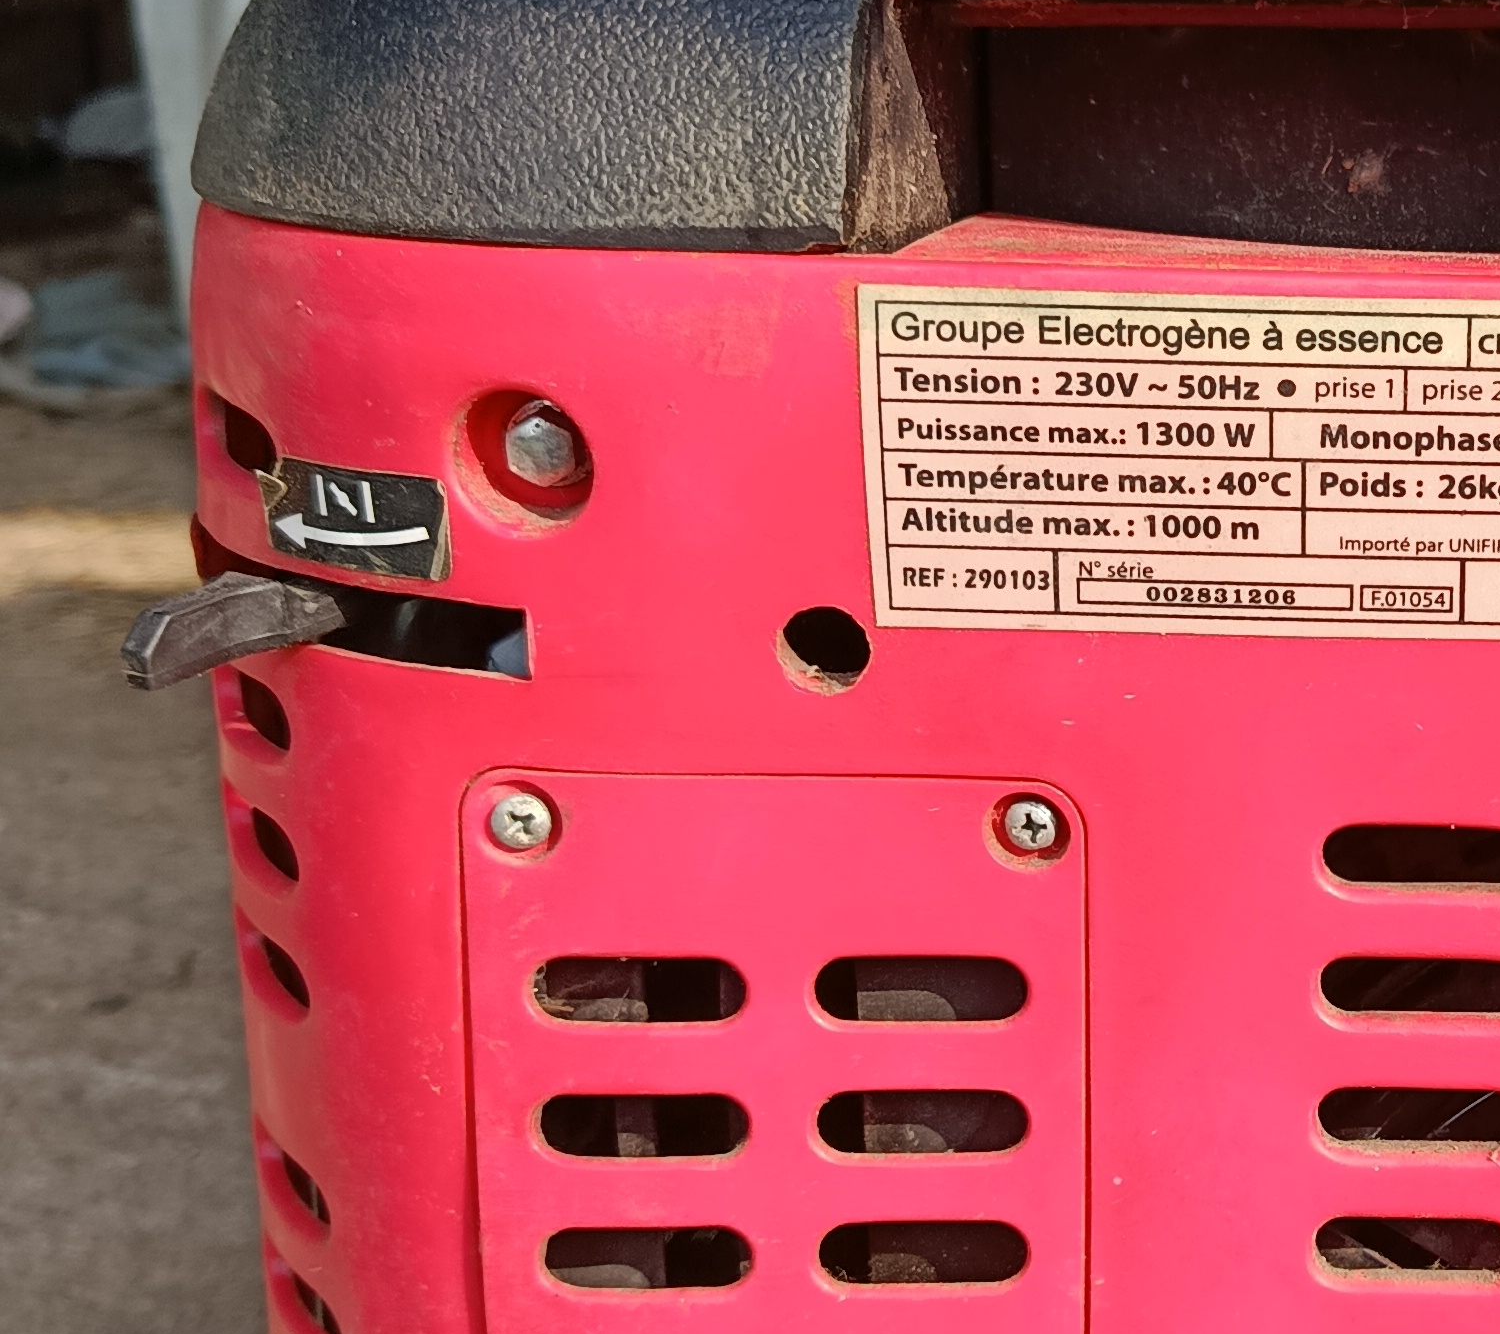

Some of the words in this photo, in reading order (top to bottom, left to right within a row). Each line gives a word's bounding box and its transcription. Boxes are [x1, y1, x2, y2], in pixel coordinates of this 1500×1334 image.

[891, 311, 1024, 351] Groupe
[1039, 315, 1250, 356] Electrogène
[1263, 321, 1283, 351] à
[1296, 329, 1443, 354] essence
[894, 367, 1021, 394] Tension
[1055, 371, 1139, 397] 230V
[1178, 375, 1260, 400] 50Hz
[1315, 377, 1375, 403] prise
[1386, 379, 1393, 398] 1
[1423, 379, 1483, 405] prise
[898, 418, 1040, 442] Puissance
[1137, 422, 1215, 447] 1300
[1224, 423, 1255, 448] W
[898, 463, 1108, 495] Température
[1119, 475, 1195, 495] max.
[1217, 472, 1291, 497] 40°C
[1320, 471, 1406, 497] Poids
[902, 507, 1033, 534] Altitude
[1043, 517, 1120, 537] max.
[1144, 515, 1221, 539] 1000
[1231, 522, 1259, 540] m
[1340, 536, 1410, 554] Importé
[1415, 539, 1445, 556] par
[903, 567, 945, 587] REF
[965, 569, 1050, 590] 290103
[1078, 560, 1101, 578] N°
[1107, 561, 1154, 579] série
[1146, 586, 1296, 605] 002831206
[1371, 590, 1446, 608] F.01054
